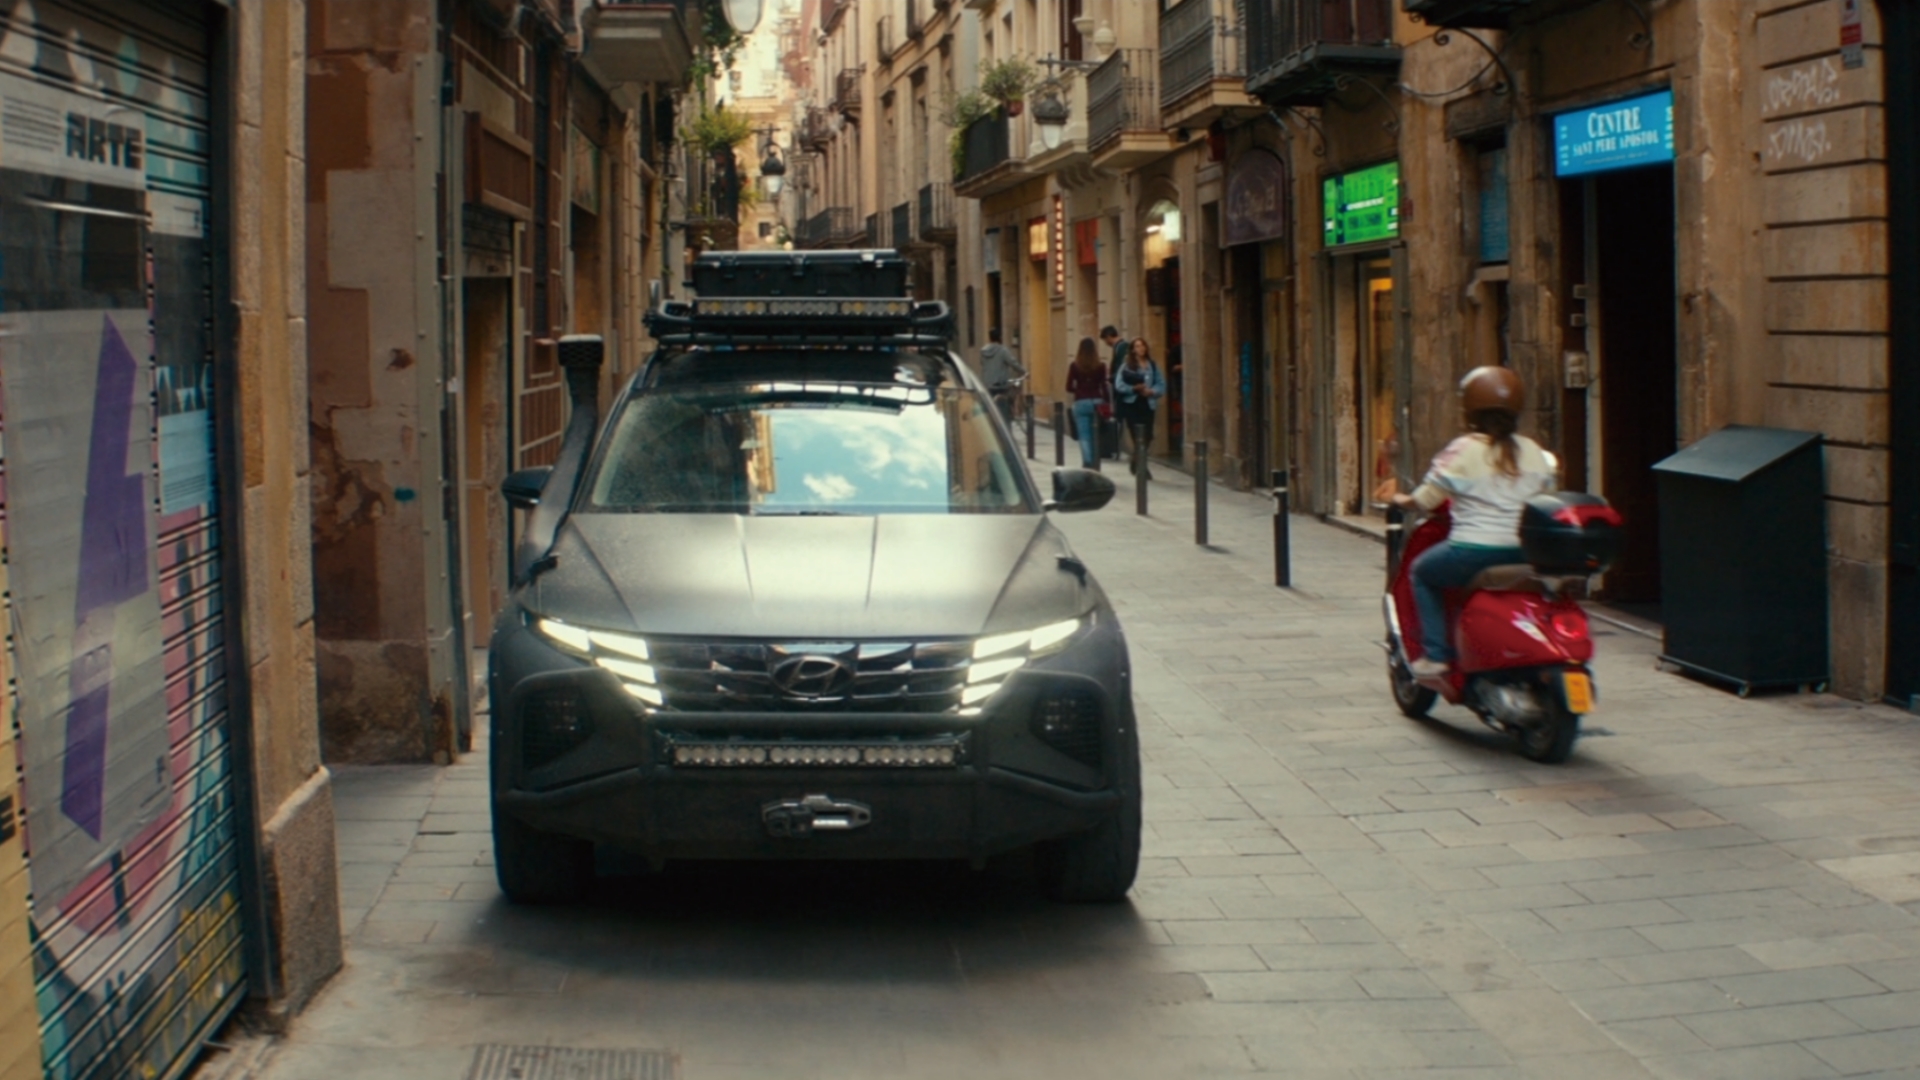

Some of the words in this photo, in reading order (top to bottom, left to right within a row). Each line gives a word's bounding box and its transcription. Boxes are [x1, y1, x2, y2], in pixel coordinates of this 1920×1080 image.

[1587, 106, 1642, 138] CENTRE
[66, 111, 142, 170] ARTE
[1572, 140, 1594, 157] SANT
